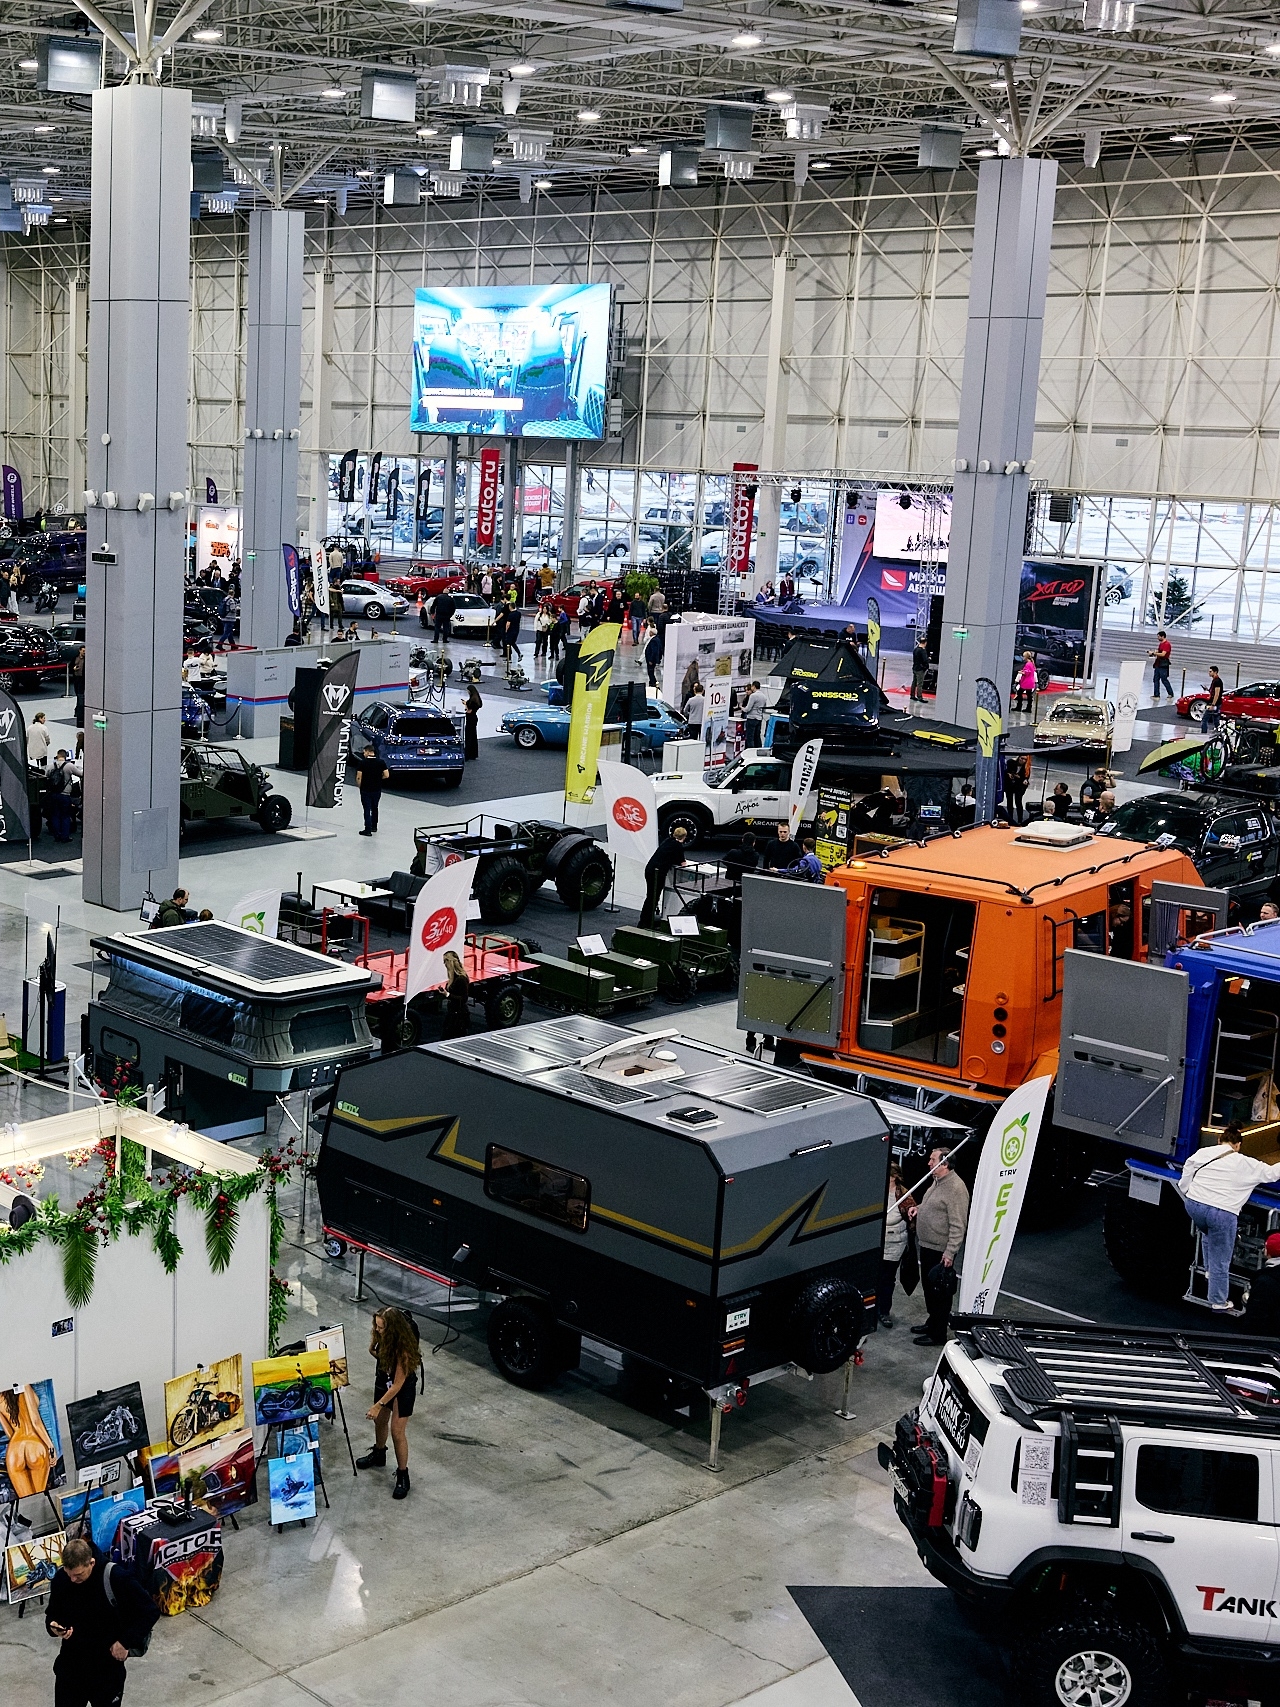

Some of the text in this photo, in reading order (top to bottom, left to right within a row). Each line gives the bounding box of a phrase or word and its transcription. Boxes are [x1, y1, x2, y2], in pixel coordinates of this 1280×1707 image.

[480, 460, 496, 536] auto.ru
[907, 583, 946, 596] АВТОШ
[908, 571, 946, 585] МОСКО
[332, 718, 352, 809] MOMENTUM
[752, 819, 779, 827] ARCANE
[998, 1168, 1018, 1177] ETRV
[938, 1402, 966, 1449] TUNING.RU
[155, 1527, 223, 1569] ICTOR
[1195, 1585, 1279, 1619] TANK
